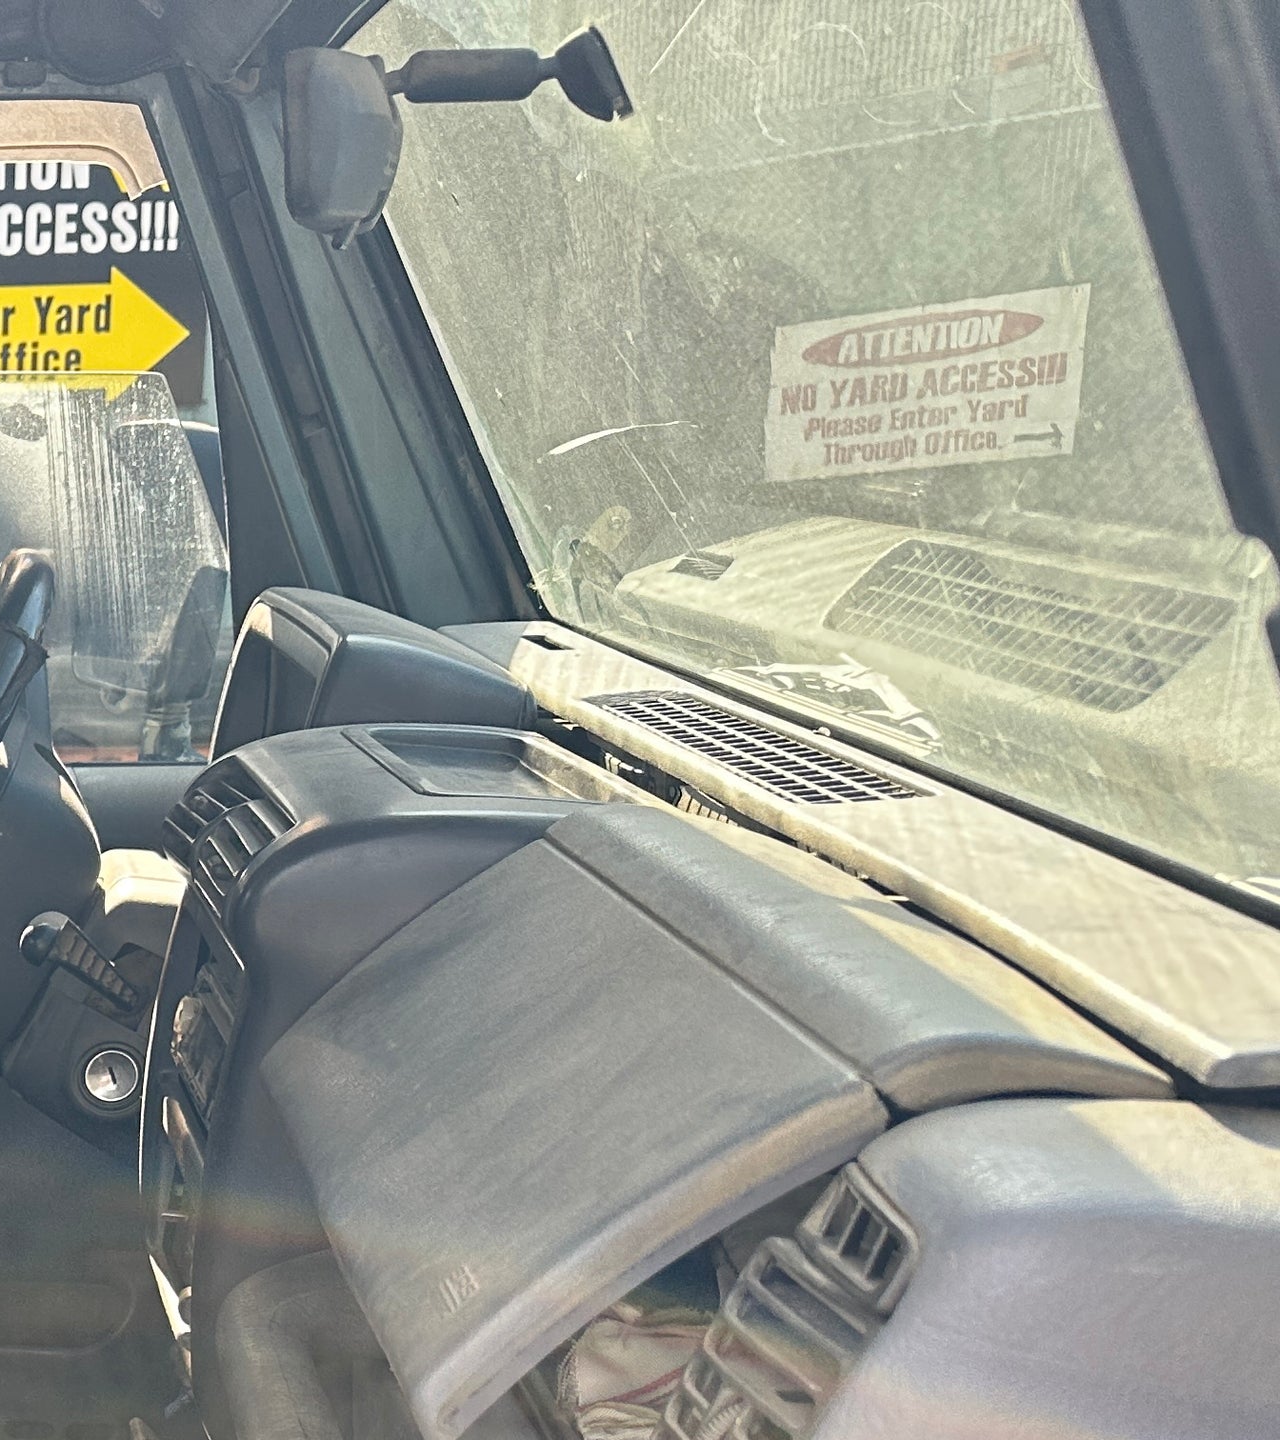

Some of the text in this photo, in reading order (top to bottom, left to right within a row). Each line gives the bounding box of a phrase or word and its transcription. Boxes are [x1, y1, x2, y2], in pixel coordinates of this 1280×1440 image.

[35, 295, 112, 335] Yard
[837, 313, 1005, 364] ATTENTION
[780, 383, 817, 415] NO
[830, 371, 908, 409] YARD
[804, 394, 1029, 442] Please Enter Yard
[823, 434, 917, 466] Through
